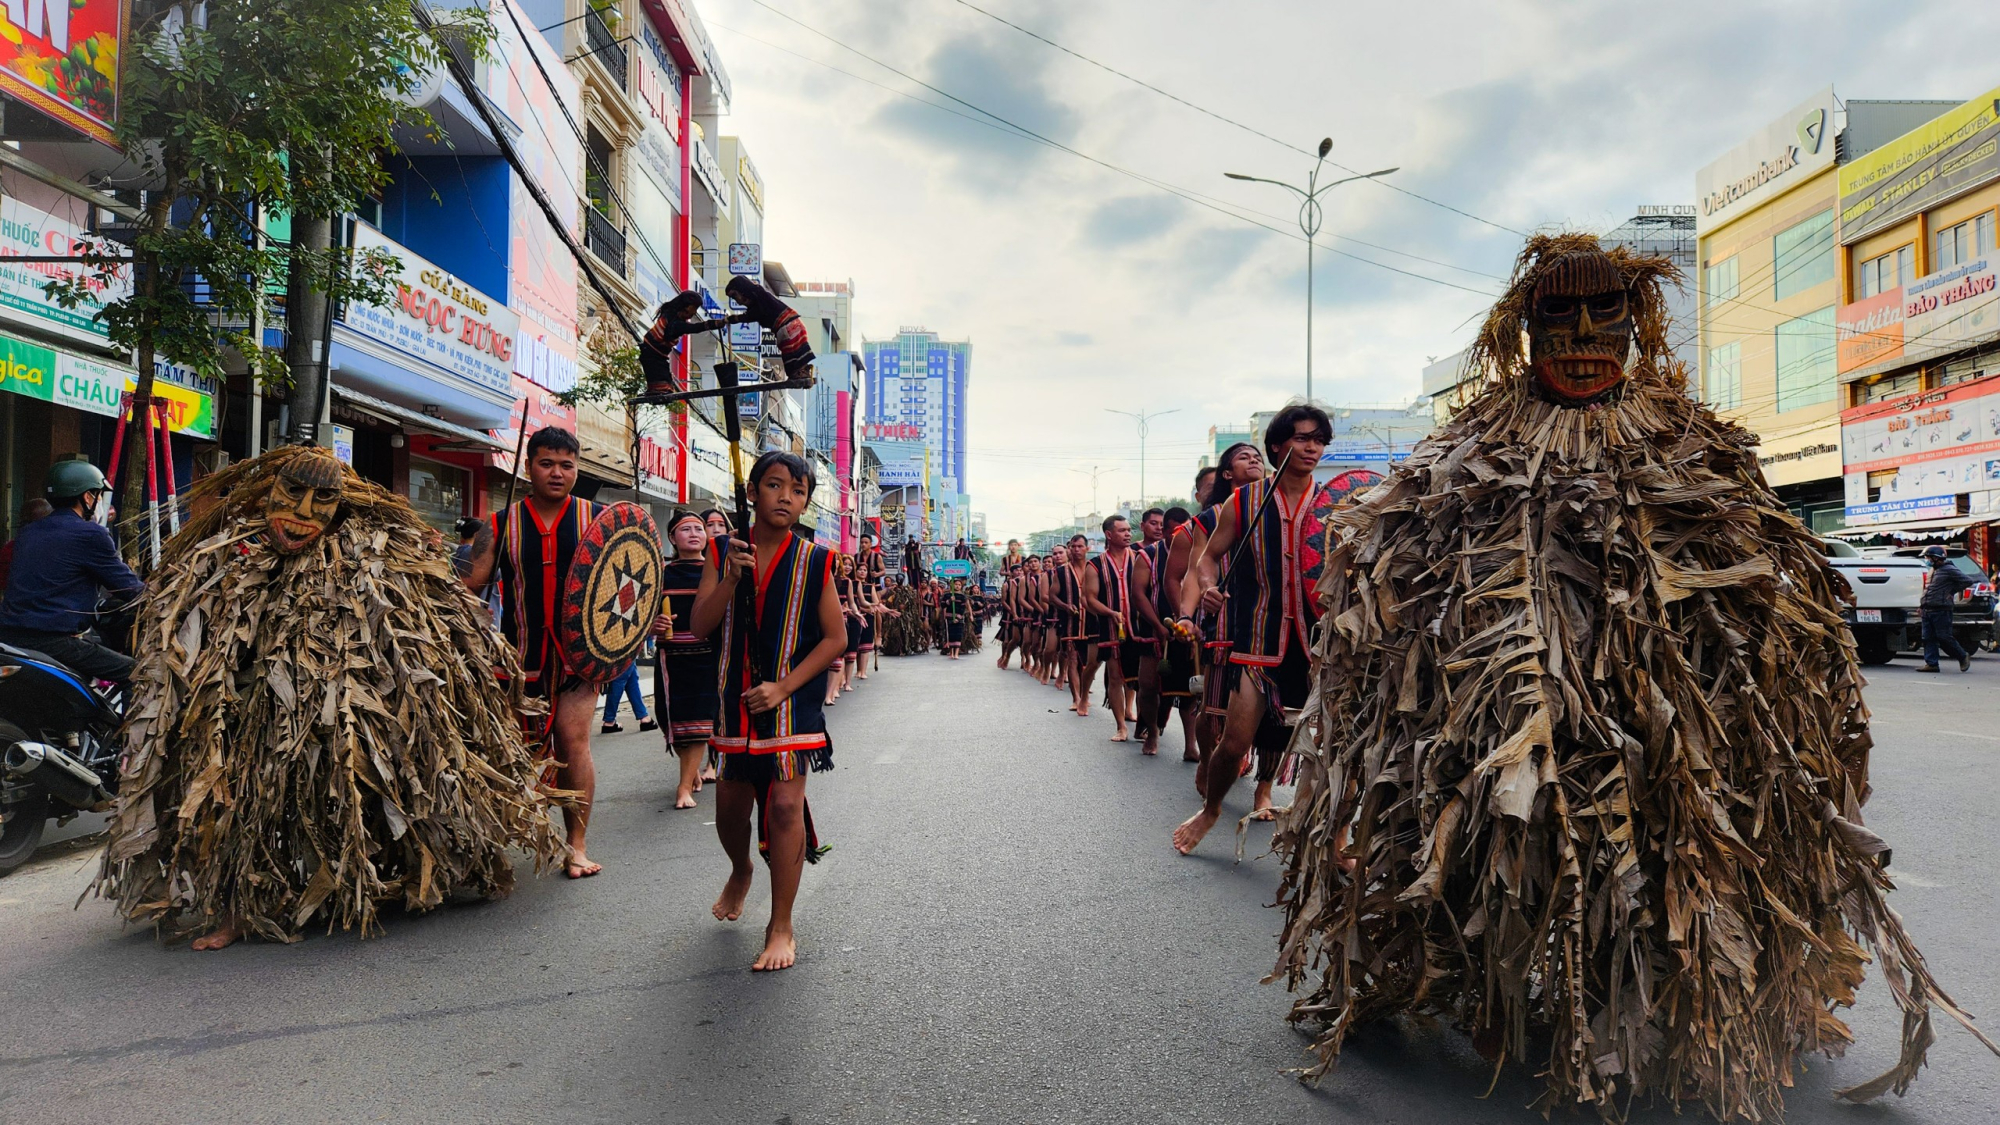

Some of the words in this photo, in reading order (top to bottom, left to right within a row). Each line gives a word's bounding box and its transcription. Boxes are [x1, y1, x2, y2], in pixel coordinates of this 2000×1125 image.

[1702, 145, 1799, 216] Vietcombank
[1849, 172, 1875, 191] TRUNG
[1877, 162, 1895, 177] TÂM
[1896, 153, 1913, 169] BẢO
[1882, 167, 1937, 204] STANLEY
[1638, 206, 1669, 215] MINH
[0, 217, 40, 248] HUỐC
[452, 287, 488, 316] HÀNG
[394, 279, 456, 334] NGỌC
[458, 314, 513, 362] HƯNG
[74, 360, 88, 372] NHÀ
[89, 364, 108, 377] THUỐC
[59, 374, 120, 407] CHÂU
[1851, 504, 1879, 515] TRUNG
[1882, 501, 1901, 511] TÂM
[1903, 498, 1916, 508] ỦY
[1918, 498, 1949, 508] NHIỆM
